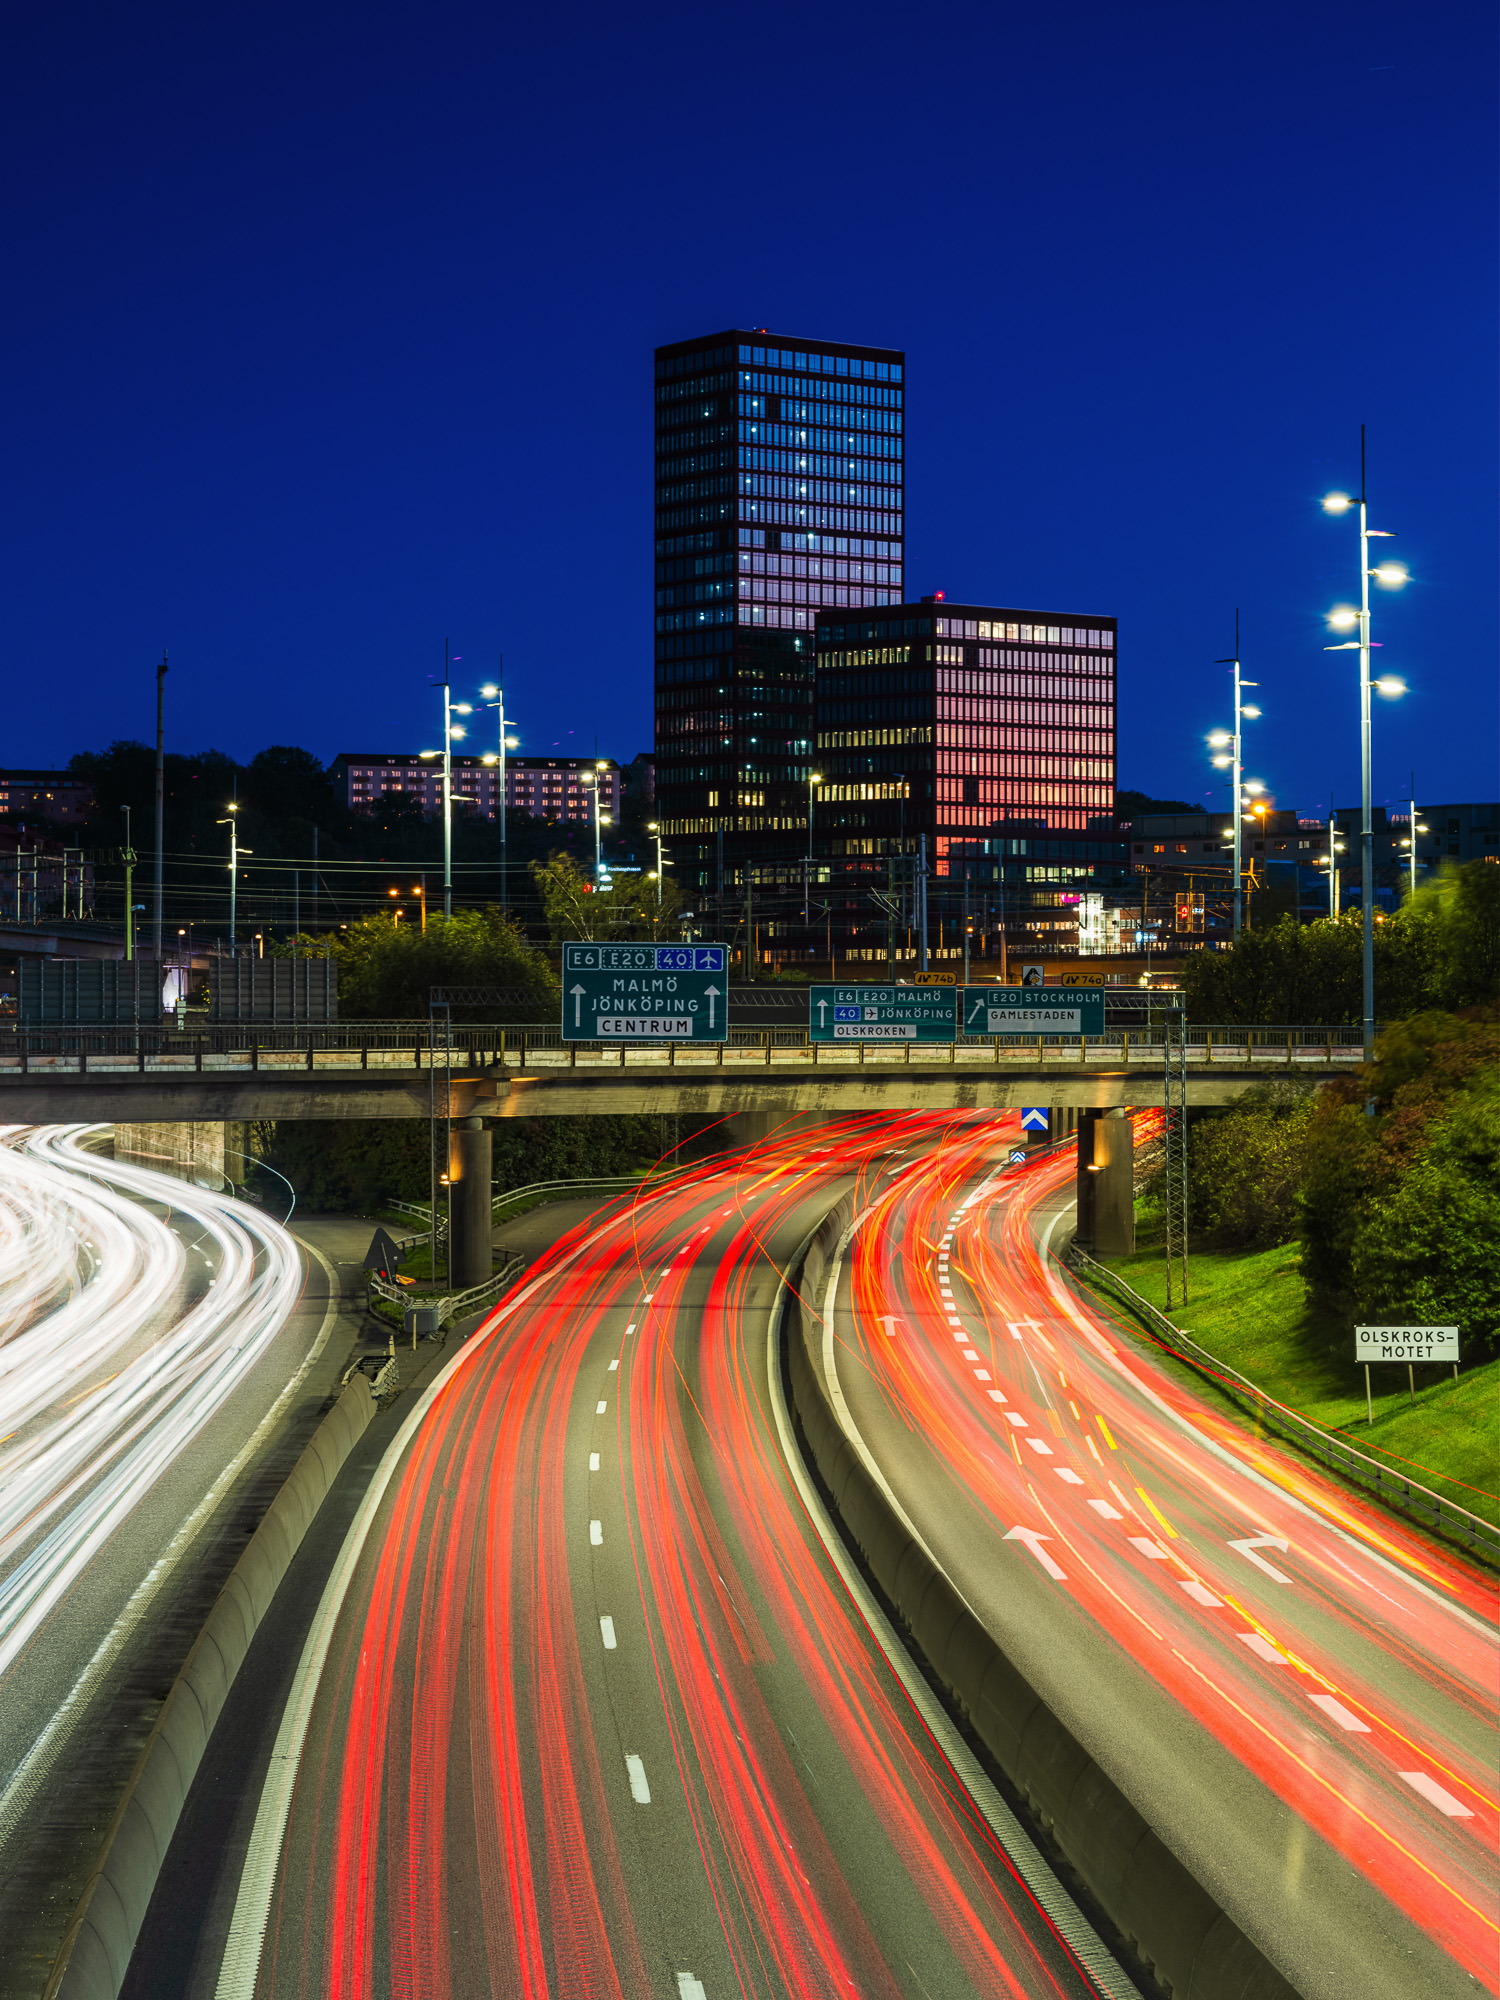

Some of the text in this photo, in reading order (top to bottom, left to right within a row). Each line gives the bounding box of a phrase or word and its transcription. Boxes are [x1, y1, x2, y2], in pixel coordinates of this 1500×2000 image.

[574, 952, 687, 966] E6 E20 40
[613, 976, 678, 992] MALMÖ
[933, 974, 954, 983] 74b
[1082, 976, 1102, 985] 74a
[838, 990, 941, 1001] E6 E20 MALMÖ
[993, 993, 1100, 1003] E20 STOCKHOLM
[592, 996, 699, 1012] JÖNKÖPING
[839, 1007, 953, 1018] 40 JÖNKÖPING
[990, 1010, 1075, 1020] GAMLESTADEN
[602, 1019, 688, 1034] CENTRUM
[837, 1026, 906, 1036] OLSKROKEN
[1360, 1331, 1454, 1343] OLSKROKS-
[1382, 1346, 1433, 1358] MOTET
